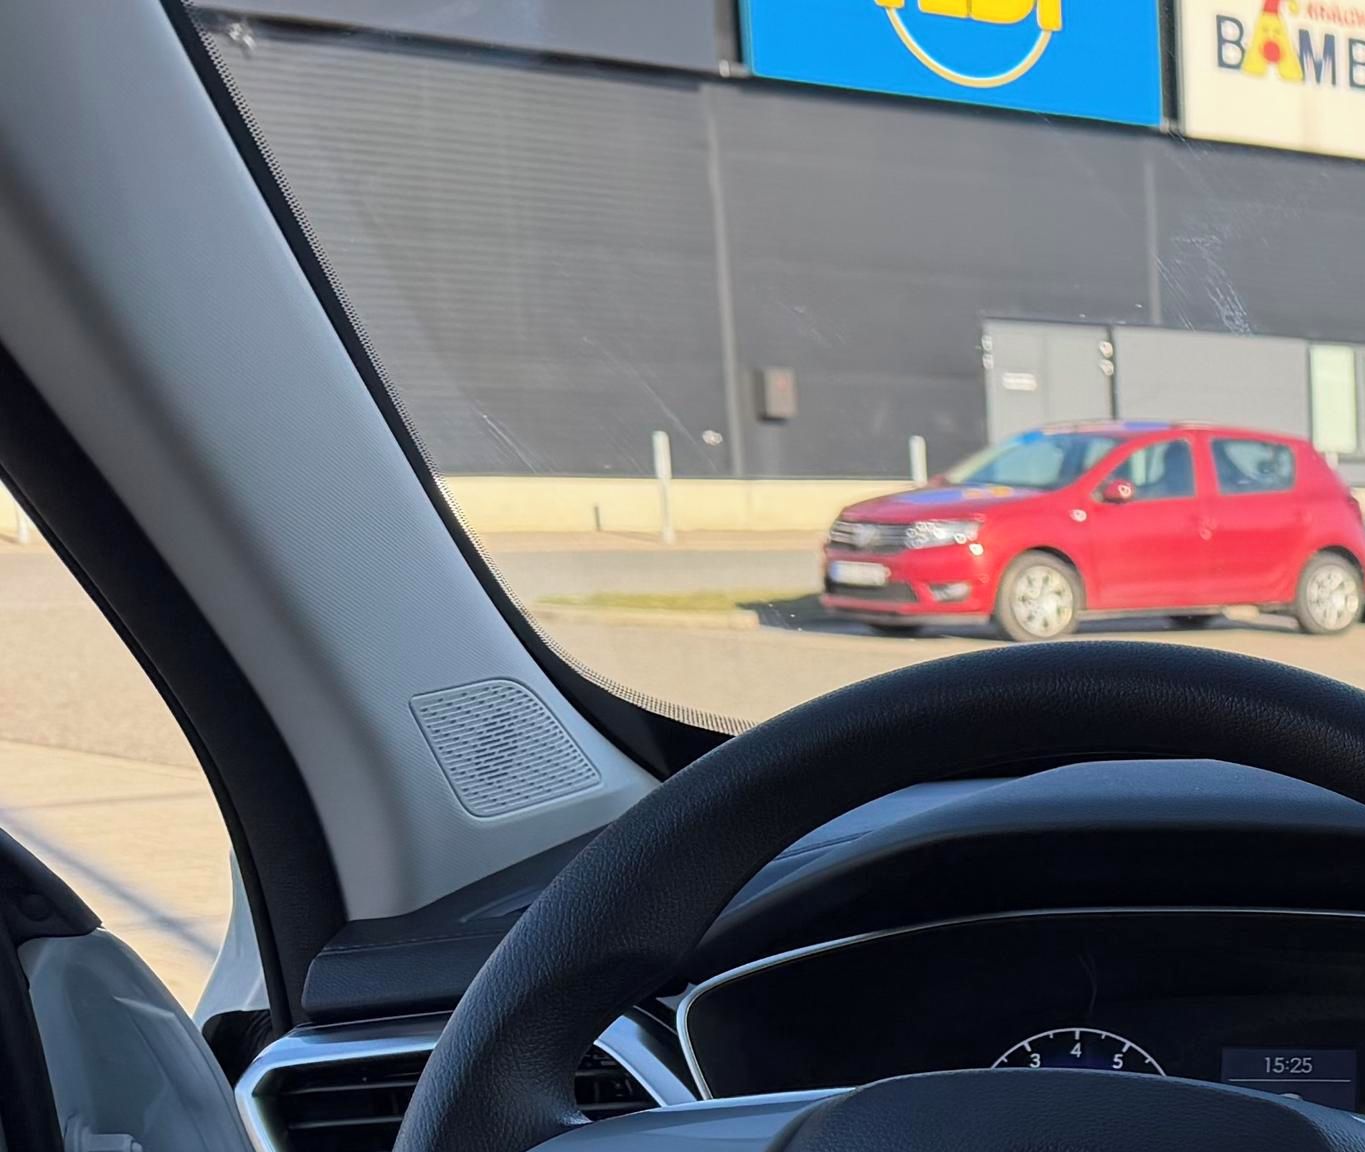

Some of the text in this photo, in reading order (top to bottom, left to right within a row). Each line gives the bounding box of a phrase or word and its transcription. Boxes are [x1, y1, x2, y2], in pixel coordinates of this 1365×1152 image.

[1070, 1043, 1082, 1057] 4
[1030, 1054, 1041, 1068] 3
[1112, 1054, 1124, 1069] 5
[1264, 1056, 1313, 1073] 15:25
